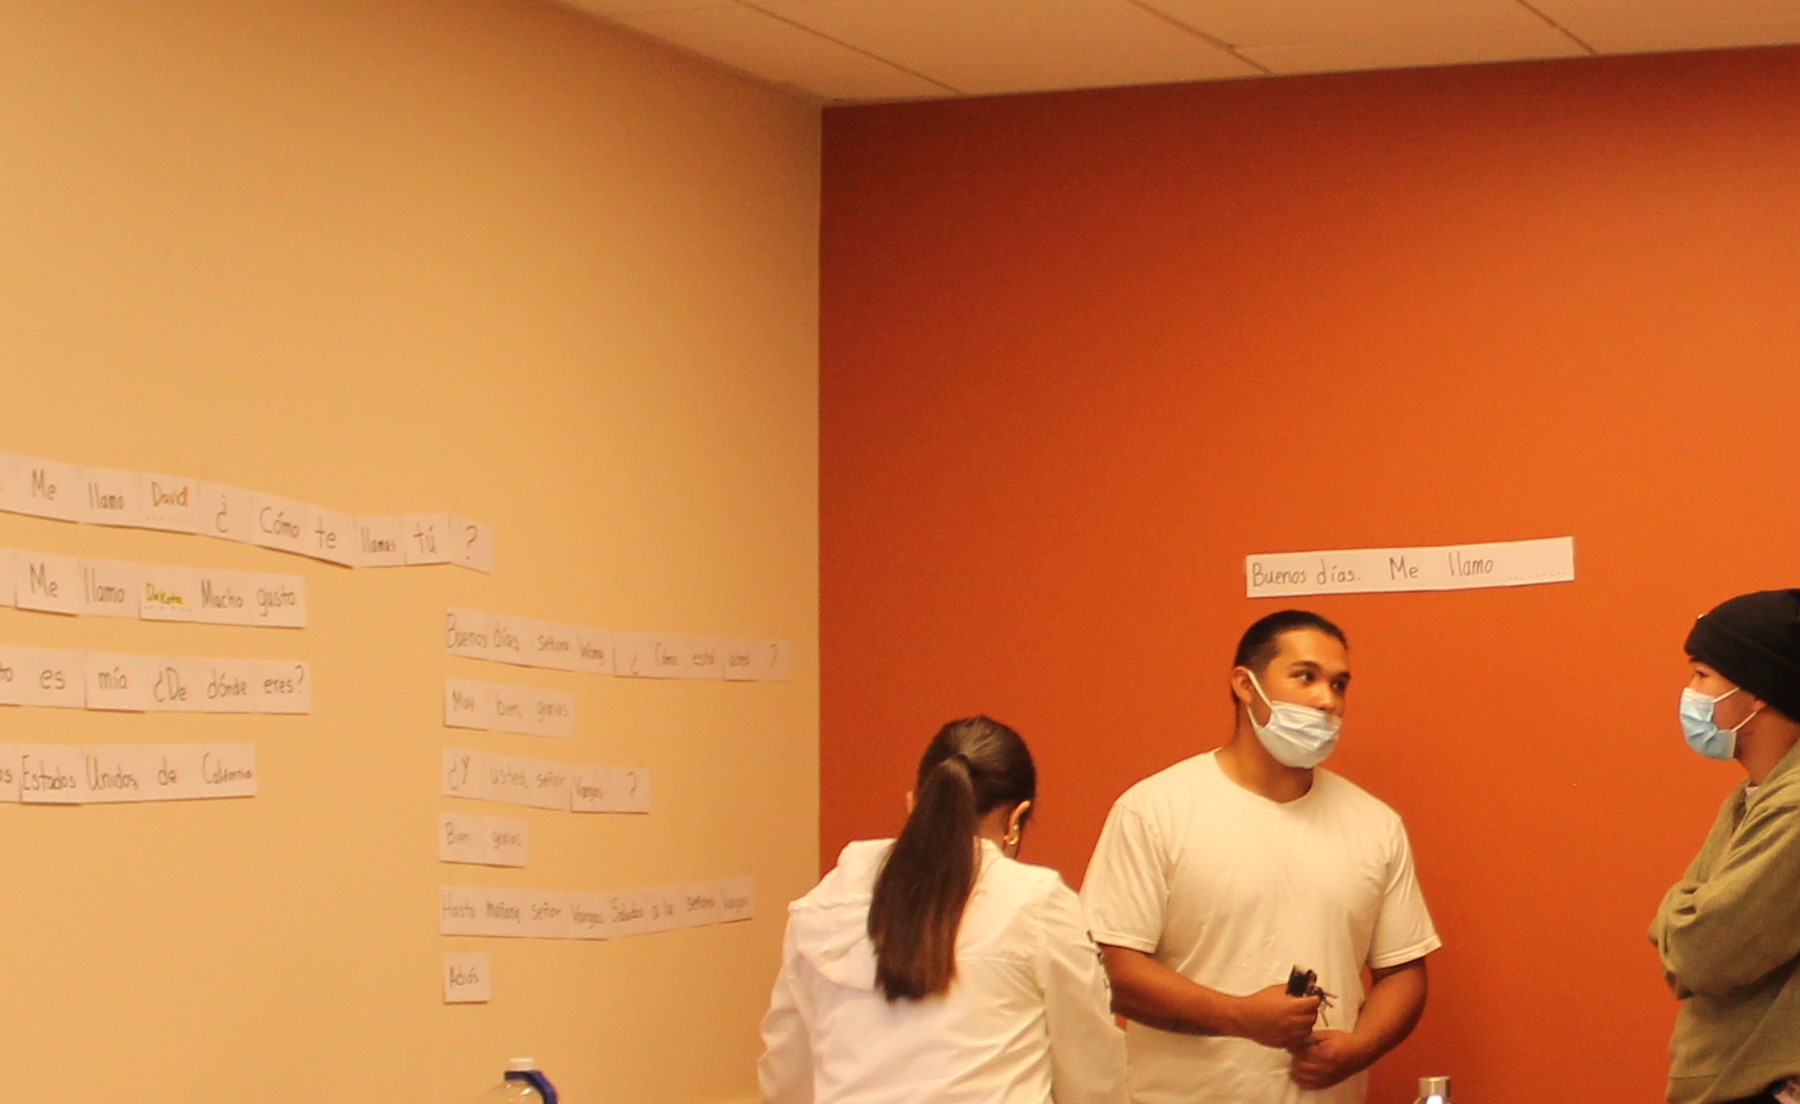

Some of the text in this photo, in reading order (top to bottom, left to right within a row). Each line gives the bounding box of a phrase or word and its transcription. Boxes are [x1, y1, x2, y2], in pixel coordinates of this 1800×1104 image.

[32, 468, 56, 501] Me
[88, 482, 124, 509] llamo
[151, 482, 189, 507] David
[259, 506, 299, 539] Cómo
[314, 517, 336, 549] te
[360, 526, 396, 553] llamas
[412, 521, 437, 554] tú
[464, 525, 478, 560] ?
[30, 563, 58, 598] Me
[84, 567, 125, 604] llamo
[201, 577, 244, 608] Mucho
[1253, 562, 1306, 587] Buenos
[1389, 557, 1419, 581] Me
[1448, 552, 1494, 577] llamo
[446, 612, 487, 648] Buenos
[39, 669, 66, 690] es
[207, 667, 247, 699] dónde
[22, 754, 76, 790] Estados
[158, 755, 176, 786] de
